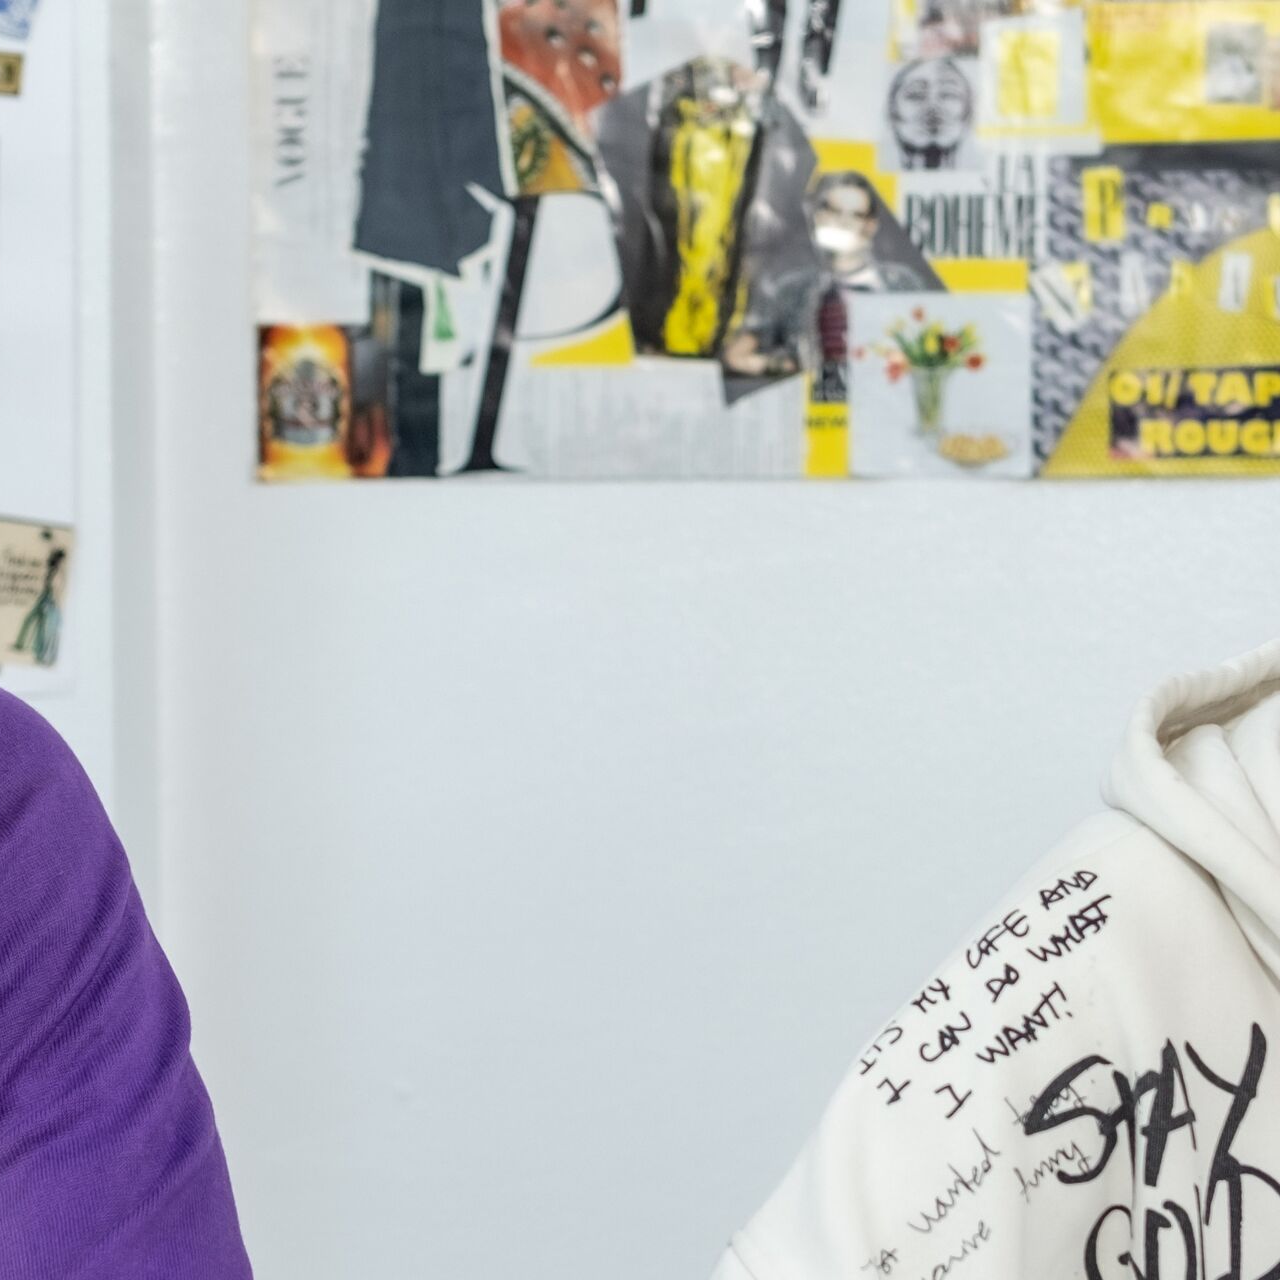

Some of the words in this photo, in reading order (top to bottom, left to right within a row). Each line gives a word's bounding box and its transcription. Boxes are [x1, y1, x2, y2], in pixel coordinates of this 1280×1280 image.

[876, 1077, 912, 1106] I
[918, 1010, 972, 1063] CAN
[985, 962, 1020, 1003] DO
[1025, 894, 1113, 963] WHAT
[910, 977, 951, 1013] MY
[1039, 869, 1098, 911] AND
[934, 1083, 973, 1119] I
[1023, 1022, 1269, 1228] STAY
